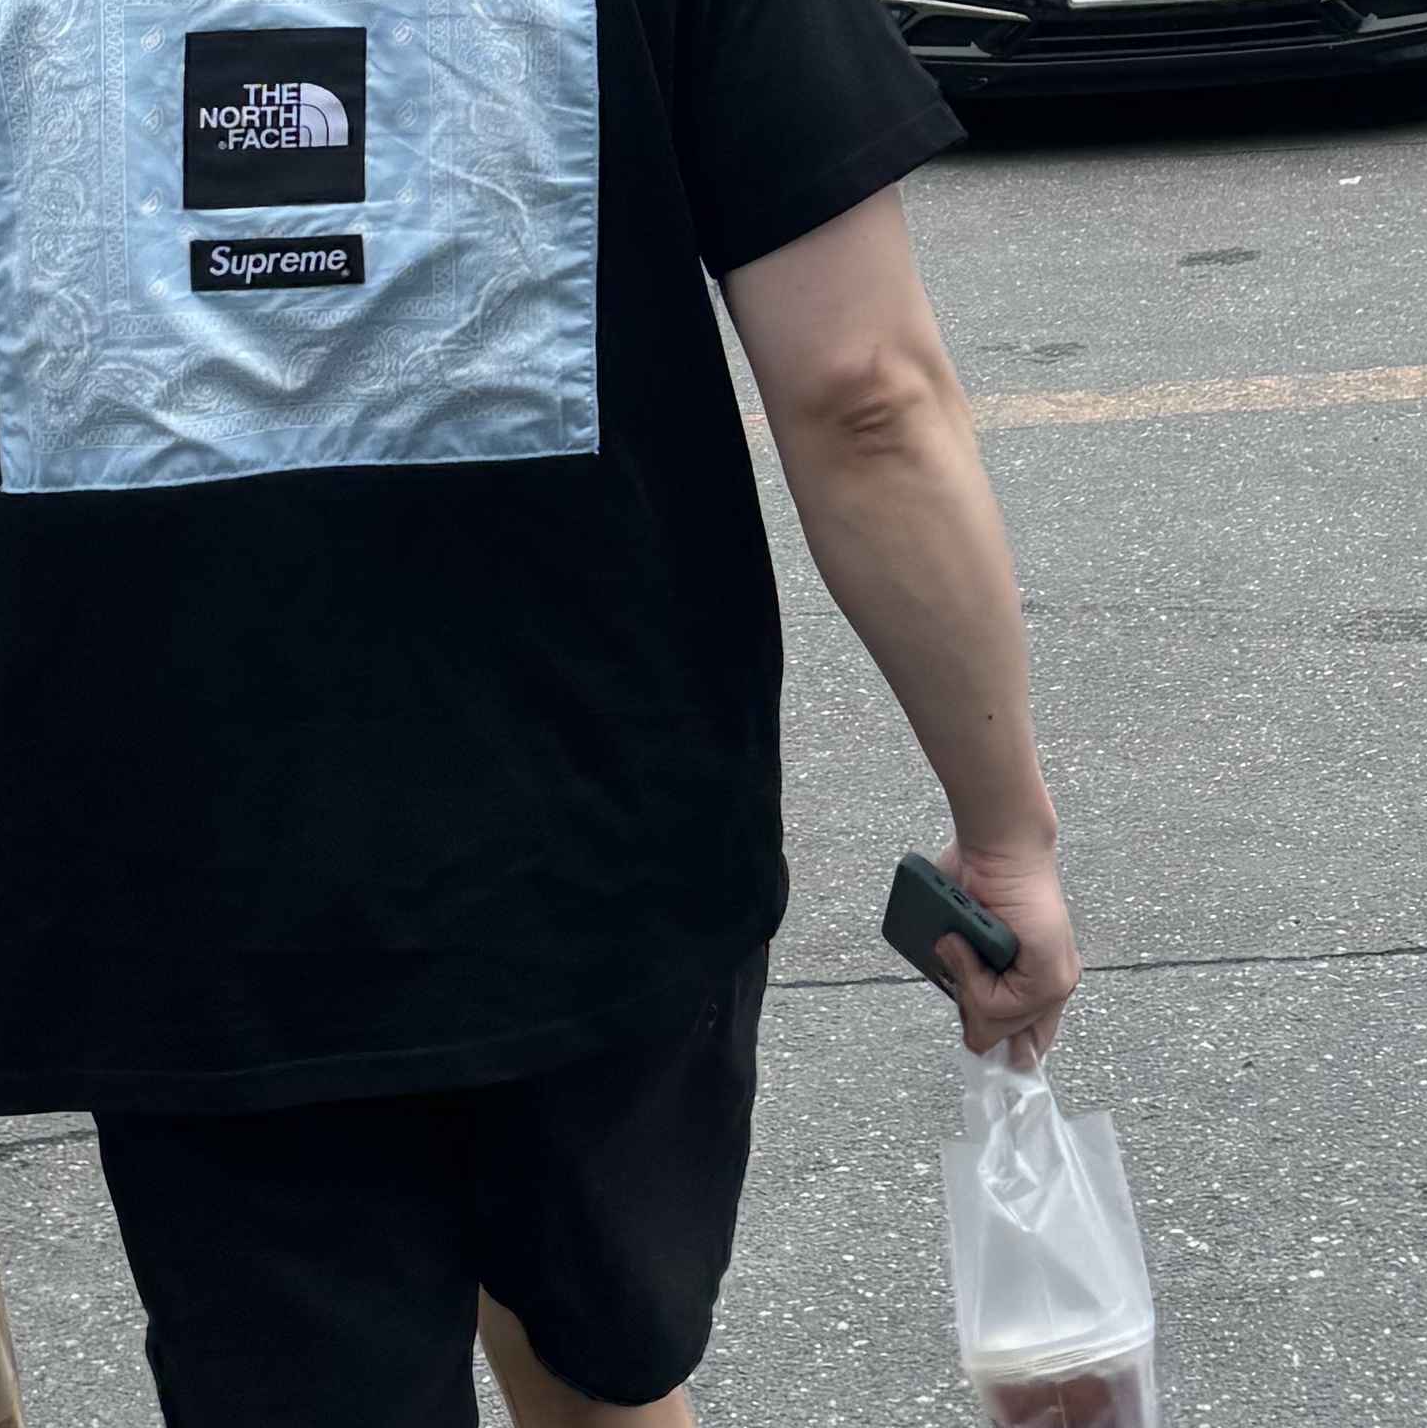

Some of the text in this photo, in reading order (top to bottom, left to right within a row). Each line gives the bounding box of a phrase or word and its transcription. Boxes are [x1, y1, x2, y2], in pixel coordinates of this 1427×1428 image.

[243, 82, 299, 105] THE
[199, 105, 298, 129] NORTH
[228, 127, 298, 151] FACE
[209, 245, 348, 284] Supreme
